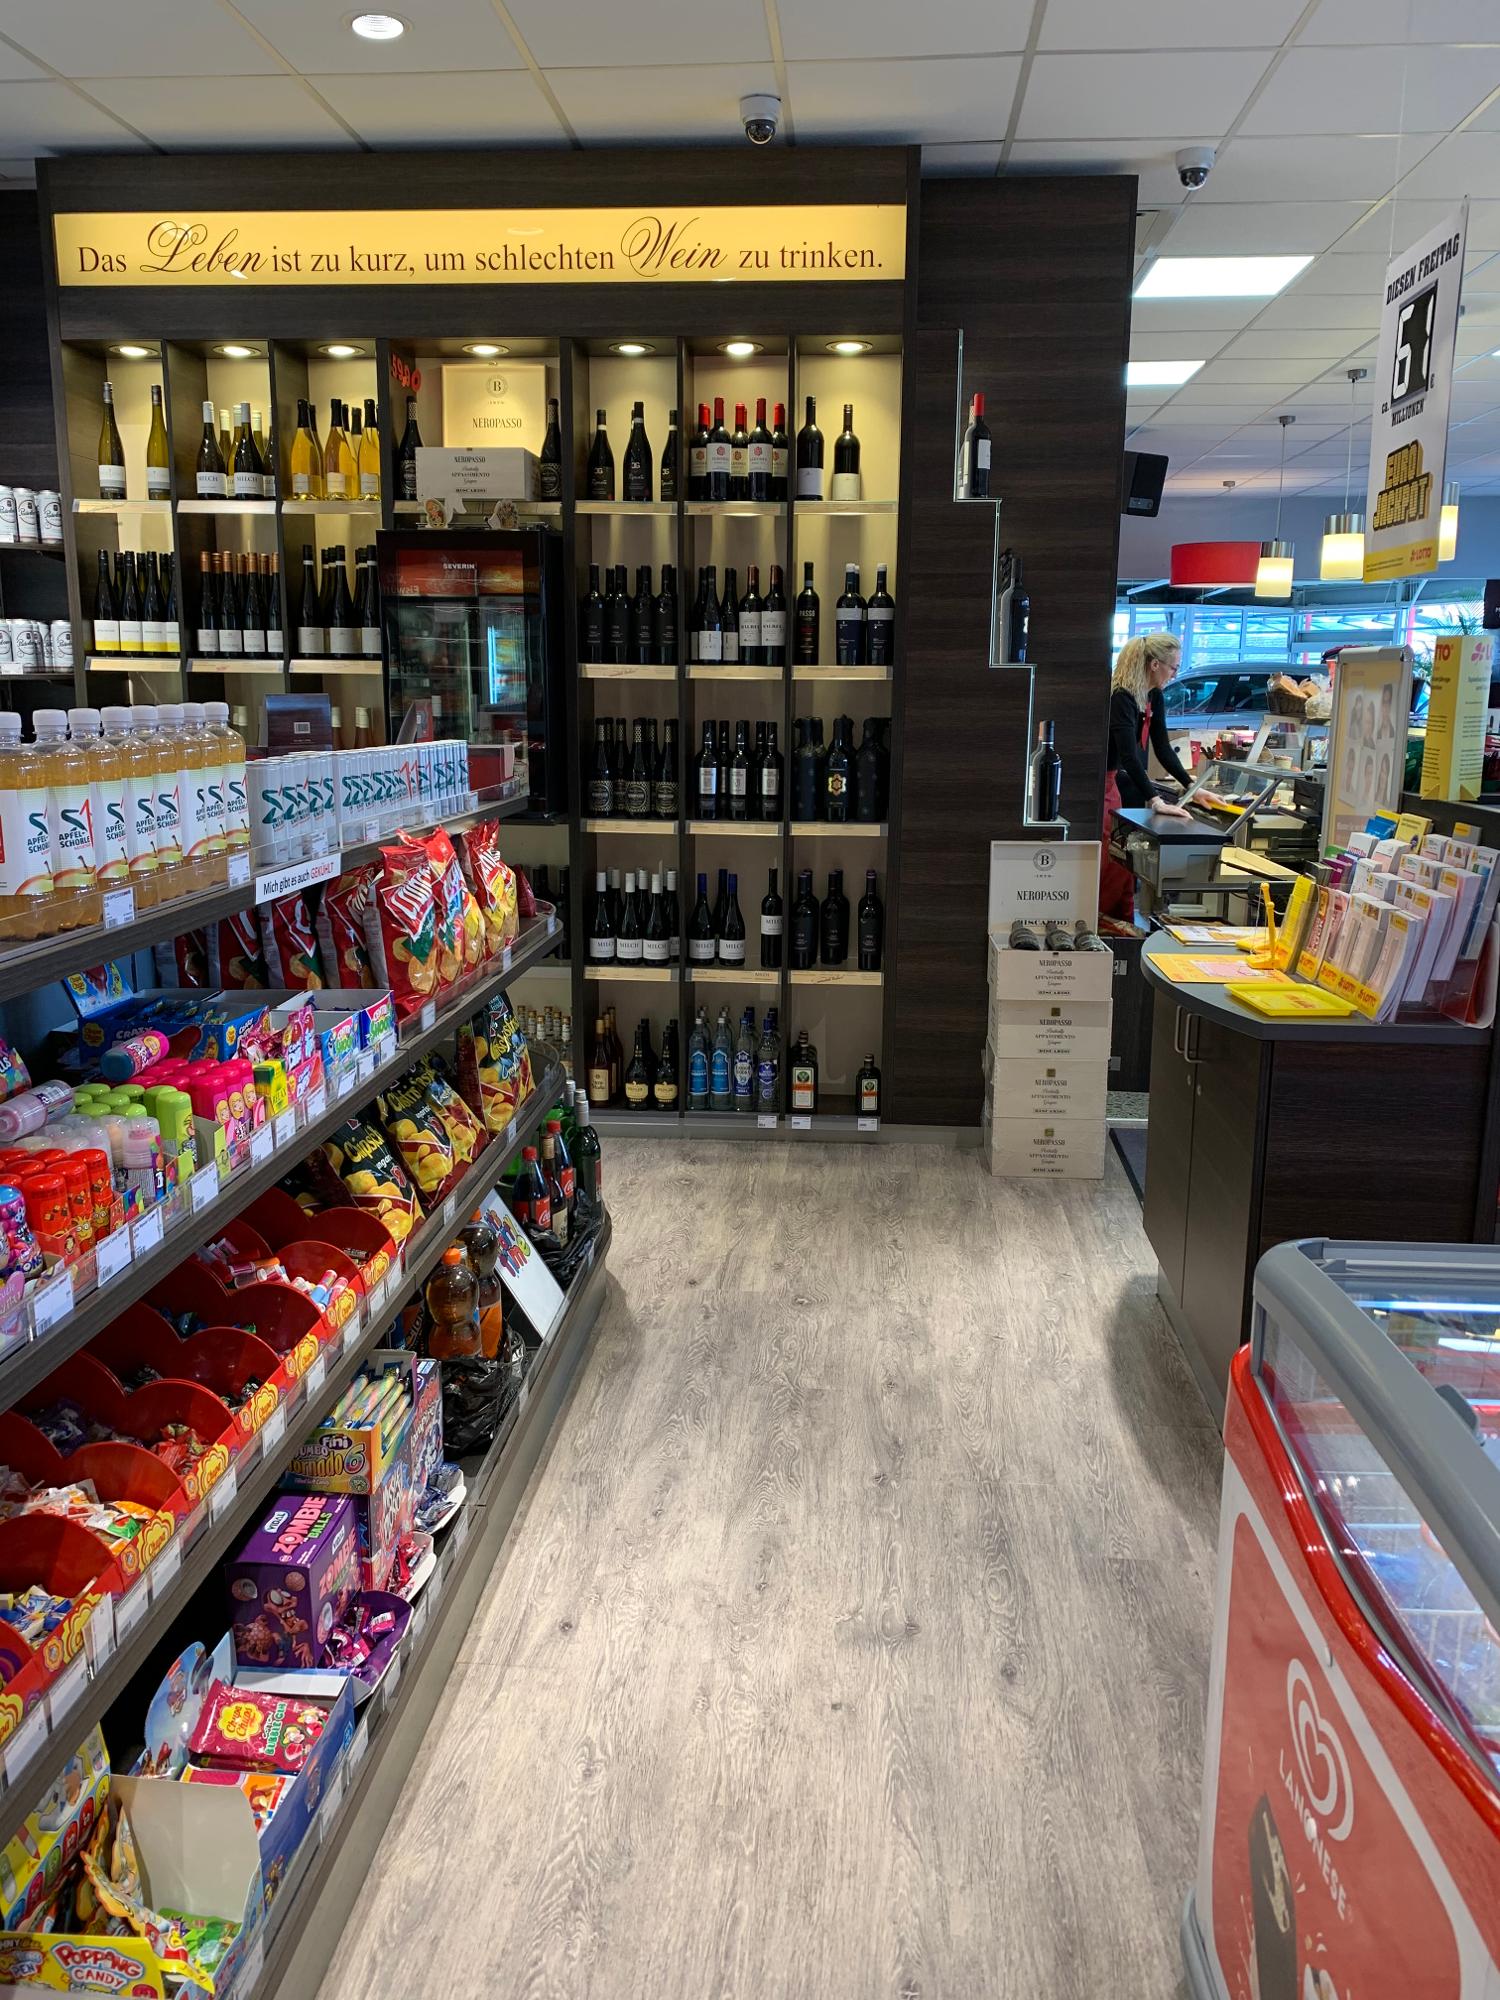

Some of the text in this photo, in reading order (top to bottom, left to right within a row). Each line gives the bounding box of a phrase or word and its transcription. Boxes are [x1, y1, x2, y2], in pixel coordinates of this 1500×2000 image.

[79, 216, 883, 277] Das Leben ist zu kurz, um schlechten Wein zu trinken.
[1386, 232, 1460, 305] DIESEN FREITAG
[472, 417, 522, 429] NEROPASSO
[1391, 398, 1425, 427] MILLIONEN
[263, 861, 334, 896] Mich gibt es auch GEKÜHLT
[1016, 891, 1070, 901] NEROPASSO
[322, 1435, 348, 1449] Fini
[271, 1495, 329, 1555] ZOMBIE
[226, 1705, 243, 1734] Chupa
[235, 1706, 254, 1738] Chups
[52, 1943, 143, 1979] POPPING
[74, 1968, 124, 1988] CANDY
